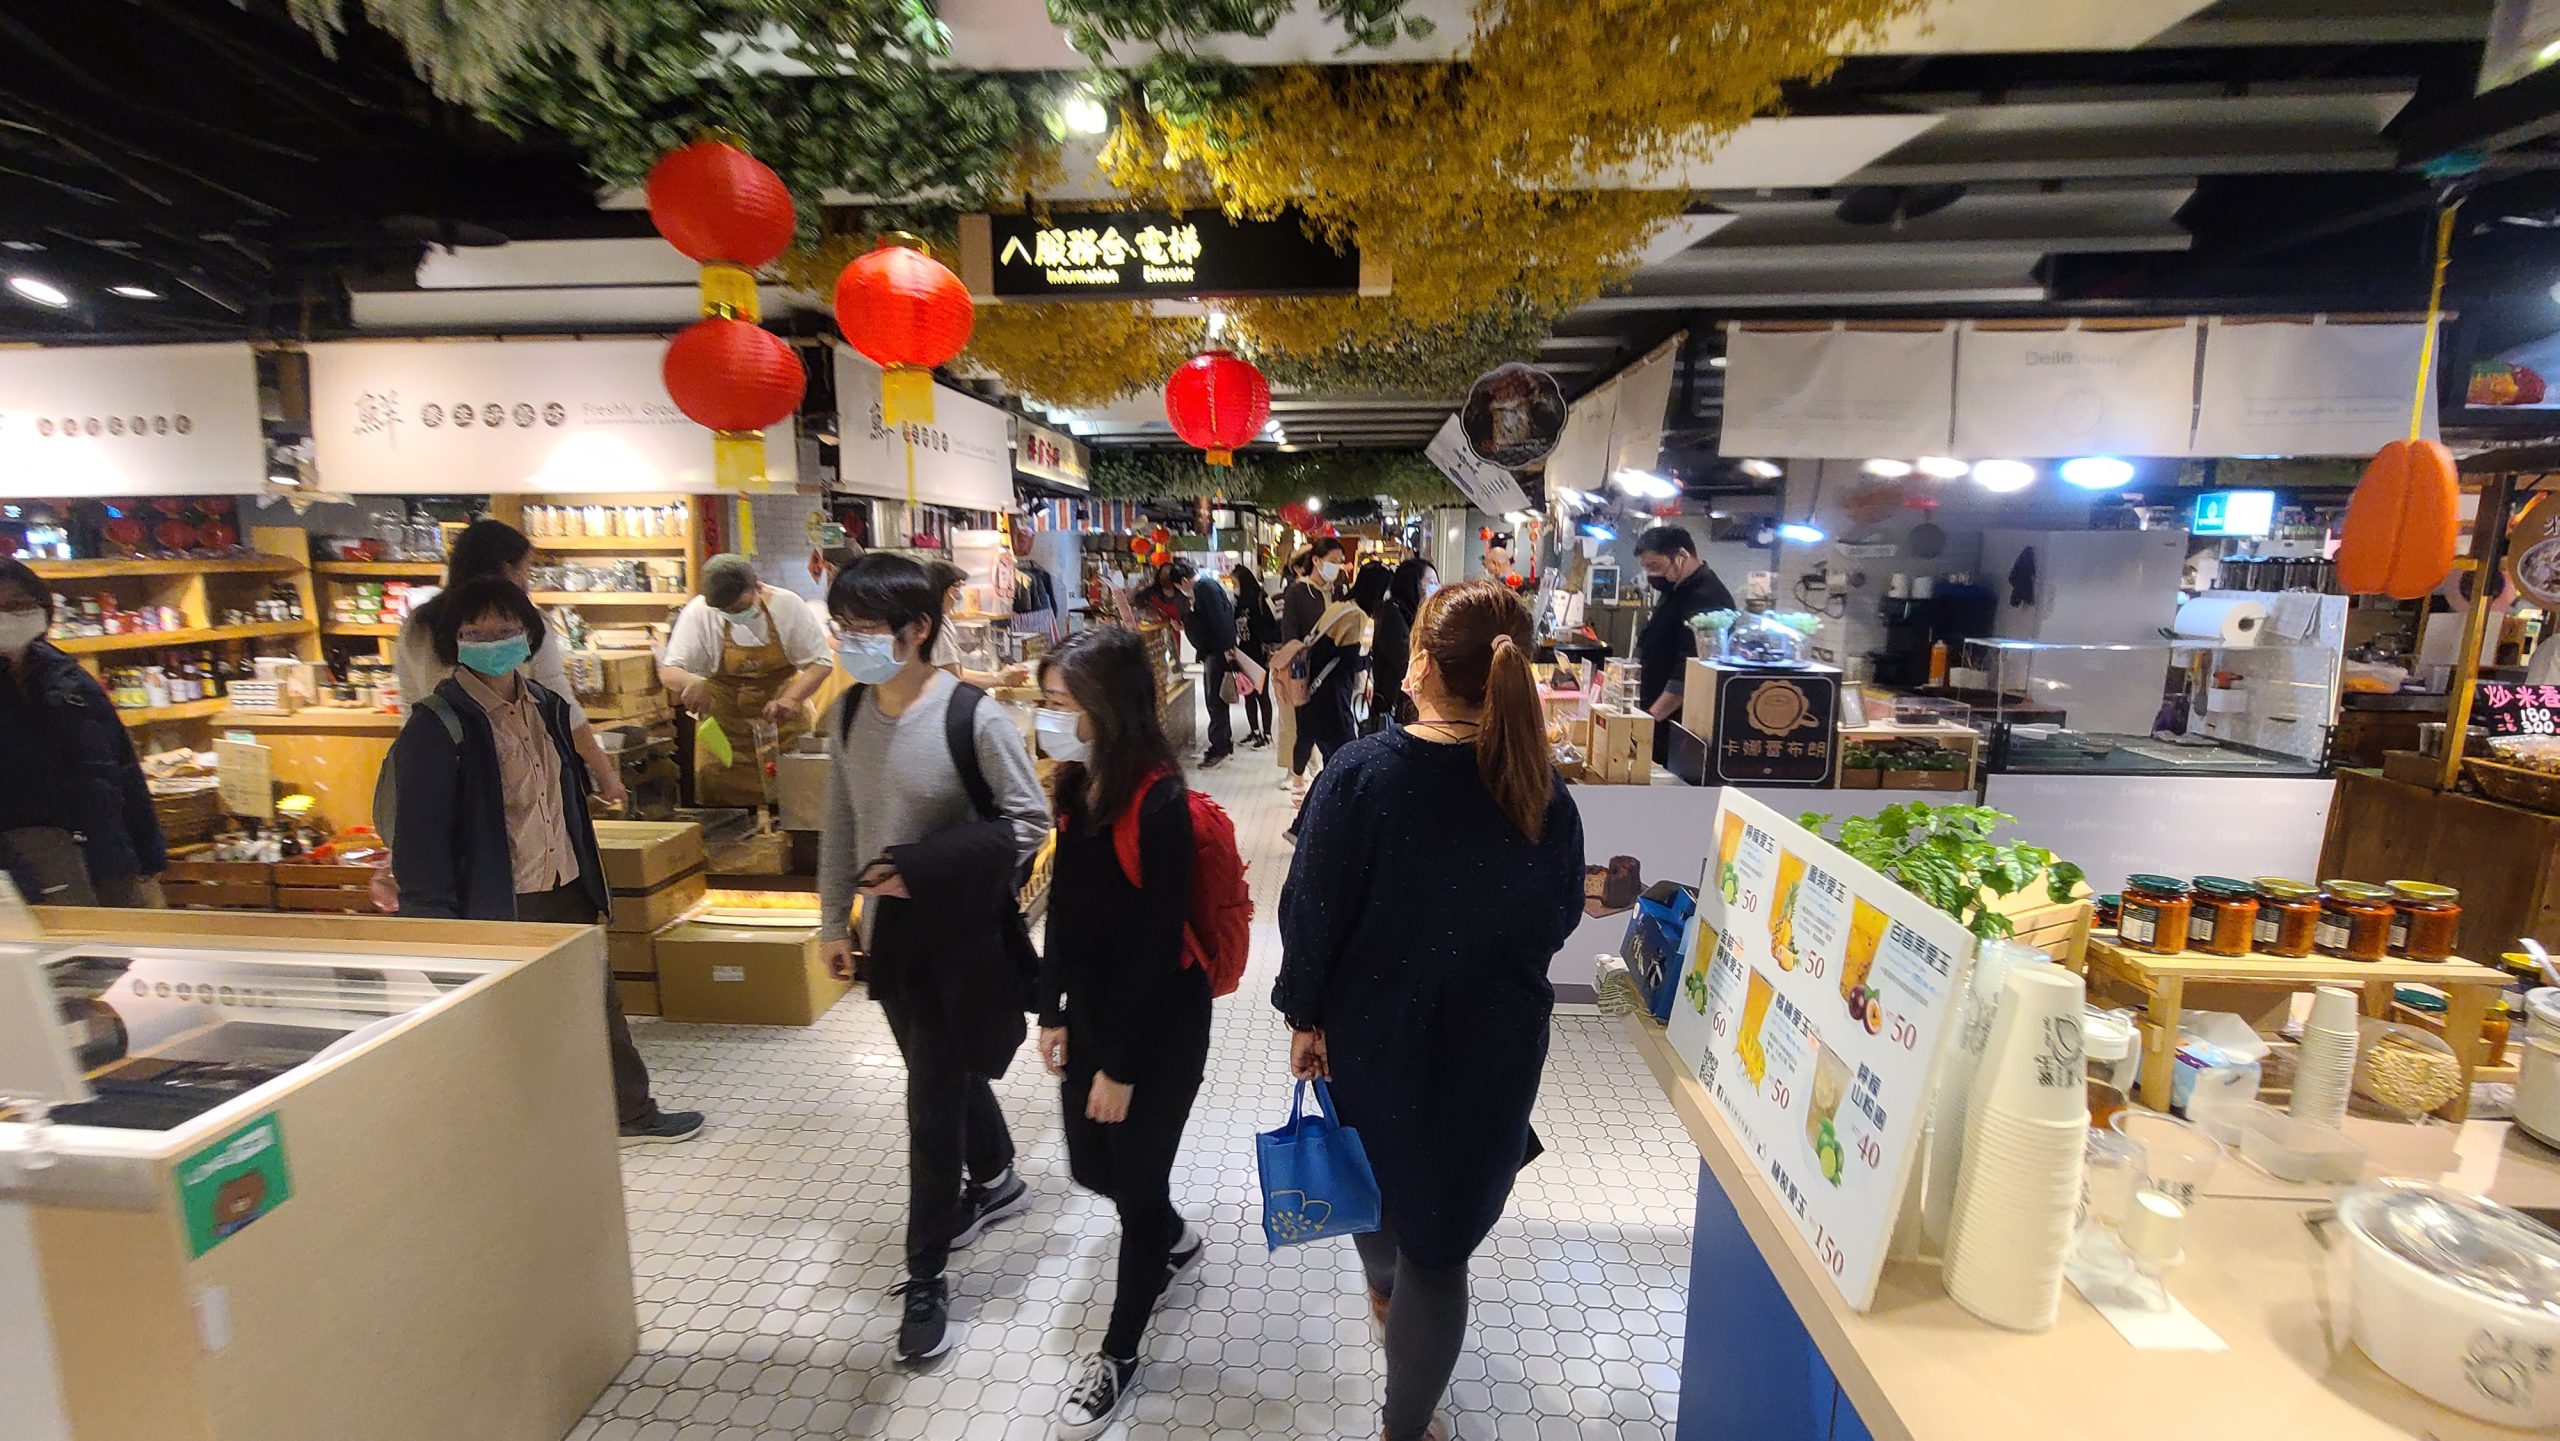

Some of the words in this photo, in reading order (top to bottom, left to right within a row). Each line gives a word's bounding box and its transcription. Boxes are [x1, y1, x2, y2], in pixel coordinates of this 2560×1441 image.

[1045, 266, 1120, 285] Information
[1142, 264, 1196, 284] Elevator
[2521, 708, 2551, 722] 180
[2521, 721, 2554, 734] 300
[1807, 864, 1848, 904] 鳳梨愛玉
[1741, 888, 1758, 913] 50
[1804, 949, 1825, 980] 50
[1890, 918, 1953, 979] 百香果愛玉
[1713, 1011, 1727, 1038] 60
[1890, 1013, 1917, 1051] 50
[1771, 1077, 1791, 1110] 50
[1856, 1133, 1881, 1170] 40
[1815, 1222, 1845, 1277] 150
